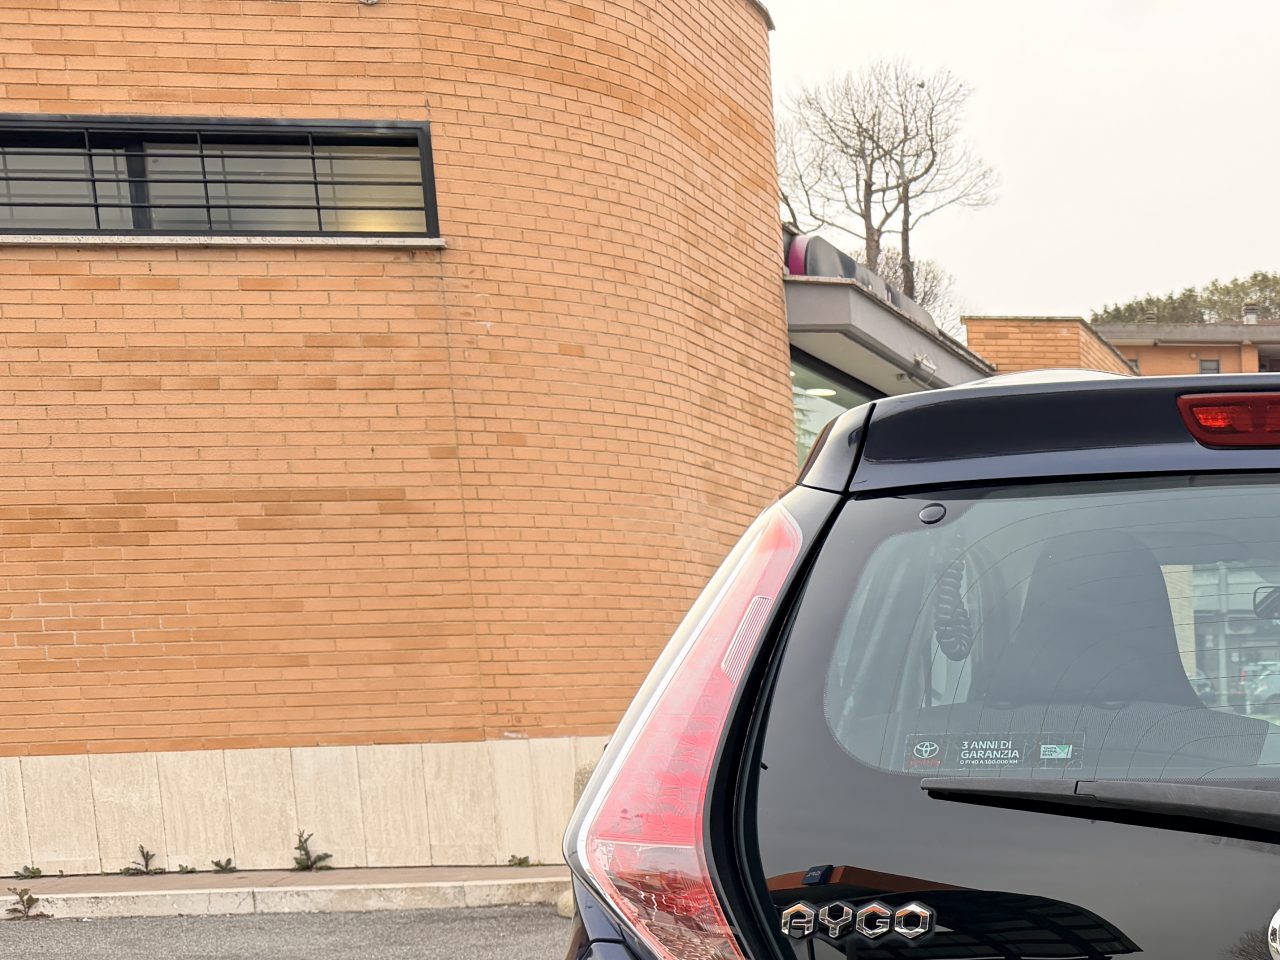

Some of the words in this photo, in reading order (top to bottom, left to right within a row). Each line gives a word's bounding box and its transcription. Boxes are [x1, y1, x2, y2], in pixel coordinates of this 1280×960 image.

[961, 741, 969, 750] 3
[970, 740, 998, 749] ANNI
[1000, 740, 1012, 749] DI
[960, 749, 1020, 759] GARANZIA
[781, 902, 930, 939] AYGO
